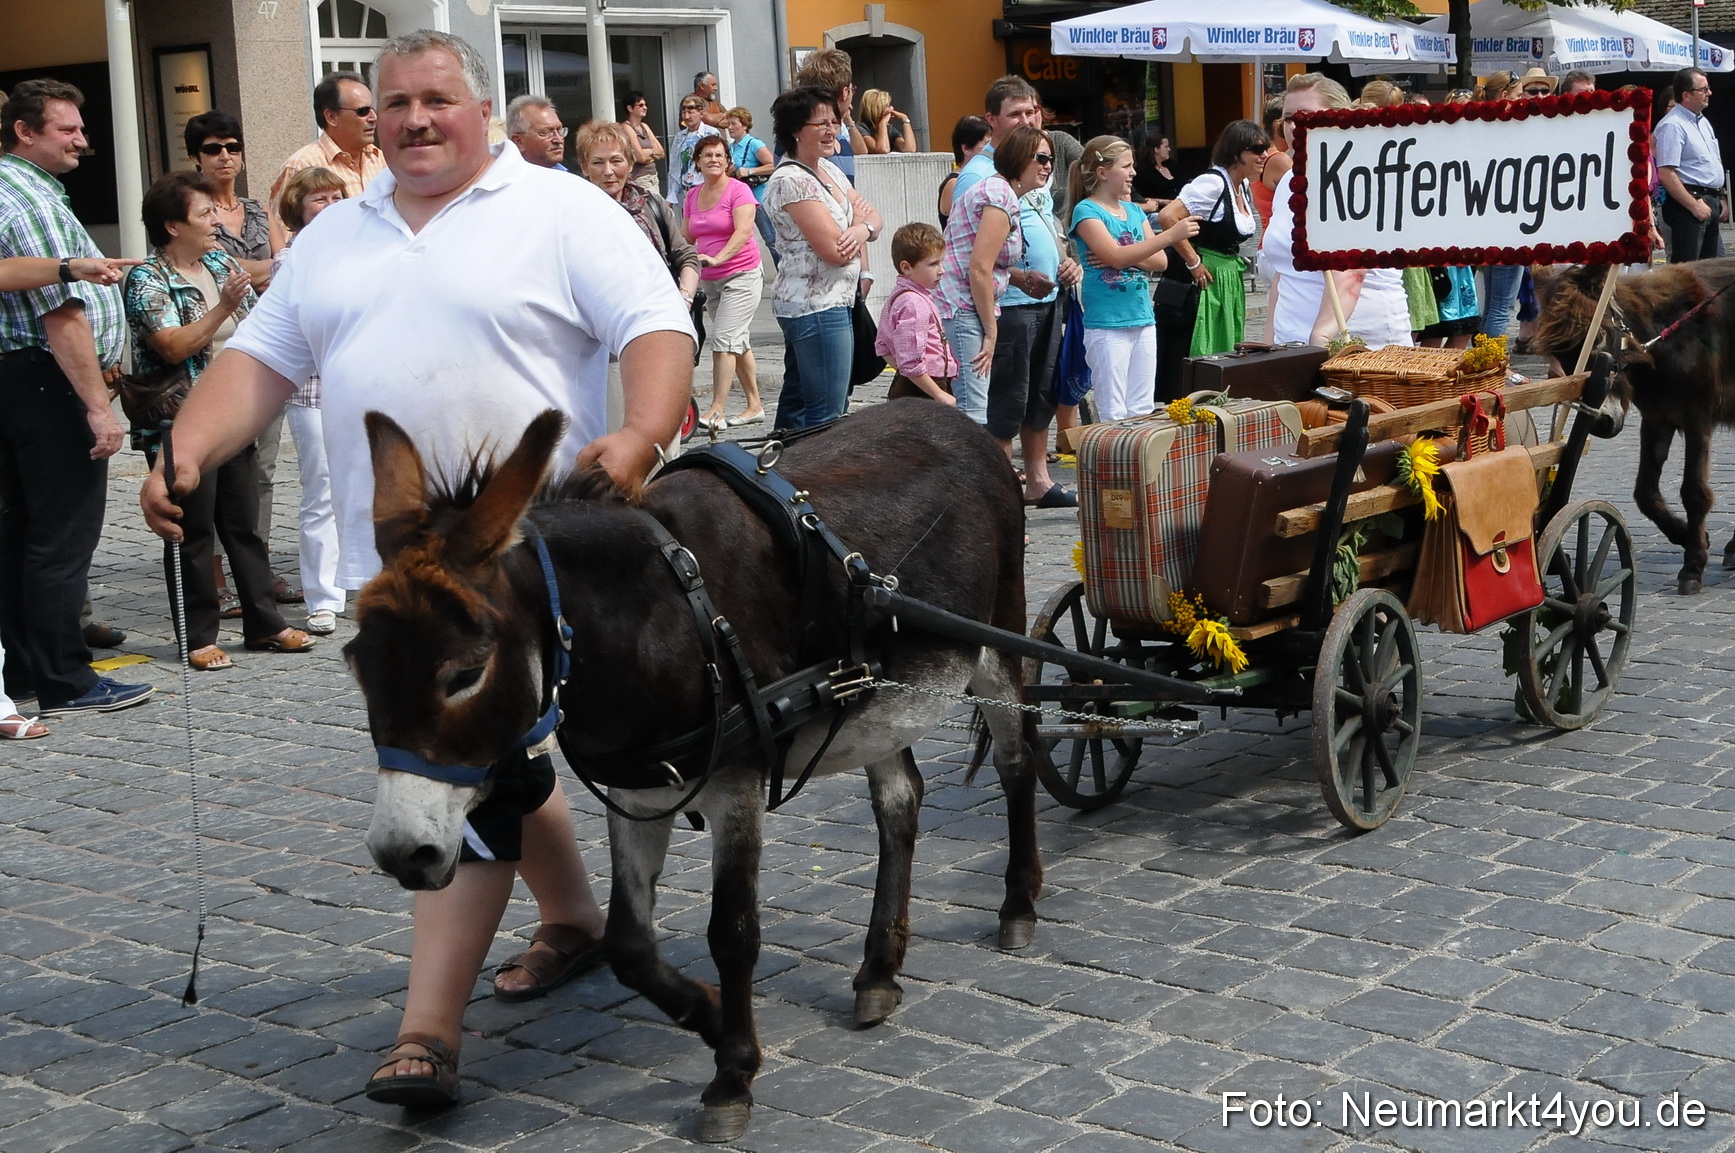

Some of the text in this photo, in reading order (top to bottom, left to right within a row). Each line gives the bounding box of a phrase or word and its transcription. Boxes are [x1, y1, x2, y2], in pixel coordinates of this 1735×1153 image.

[258, 1, 278, 19] 47
[1069, 27, 1150, 43] Winkler Bräu
[1206, 27, 1296, 44] Winkler Bräu
[1347, 31, 1391, 48] Winkler Bräu
[1413, 35, 1446, 53] Winkler Bräu
[1472, 36, 1530, 52] inkler Bräu
[1565, 37, 1623, 53] Winkler Bräu
[1657, 40, 1709, 61] Winkler Bäu
[174, 84, 199, 93] WÖHRL
[1320, 131, 1620, 234] Kofferwagerl
